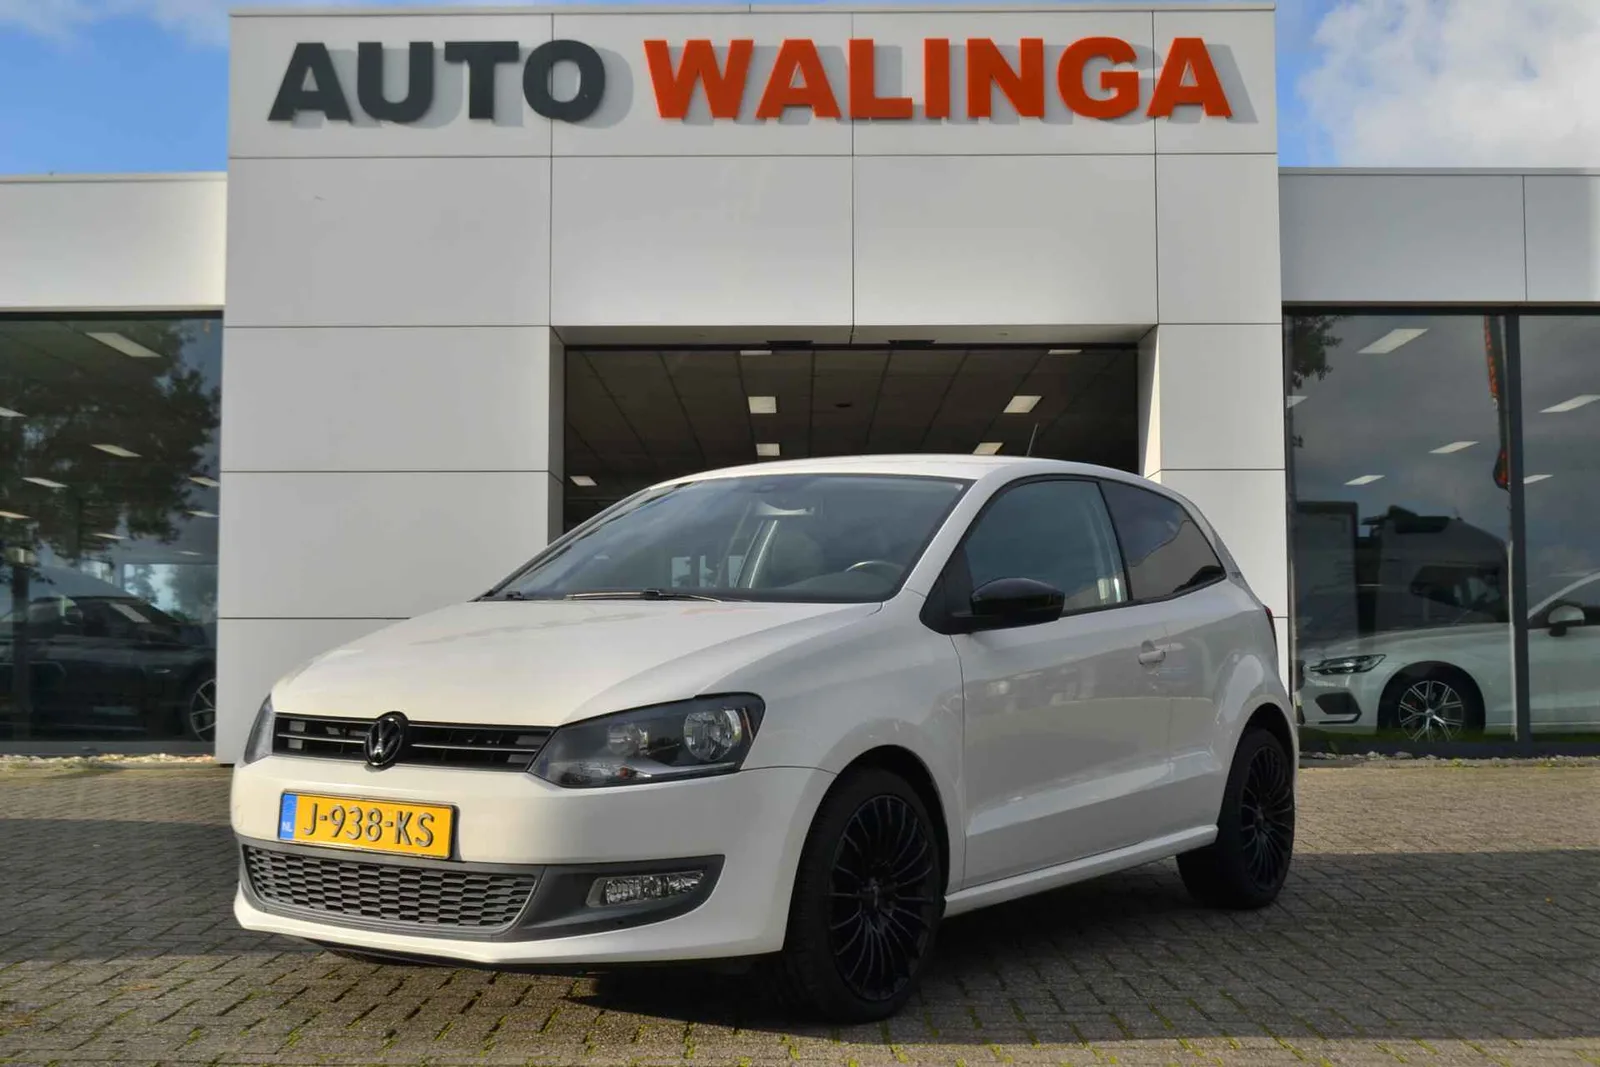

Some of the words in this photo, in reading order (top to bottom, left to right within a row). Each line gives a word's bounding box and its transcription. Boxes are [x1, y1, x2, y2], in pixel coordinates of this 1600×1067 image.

[268, 39, 606, 125] AUTO
[643, 37, 1232, 120] WALINGA
[281, 821, 294, 833] NL
[303, 803, 435, 848] J-938-KS
